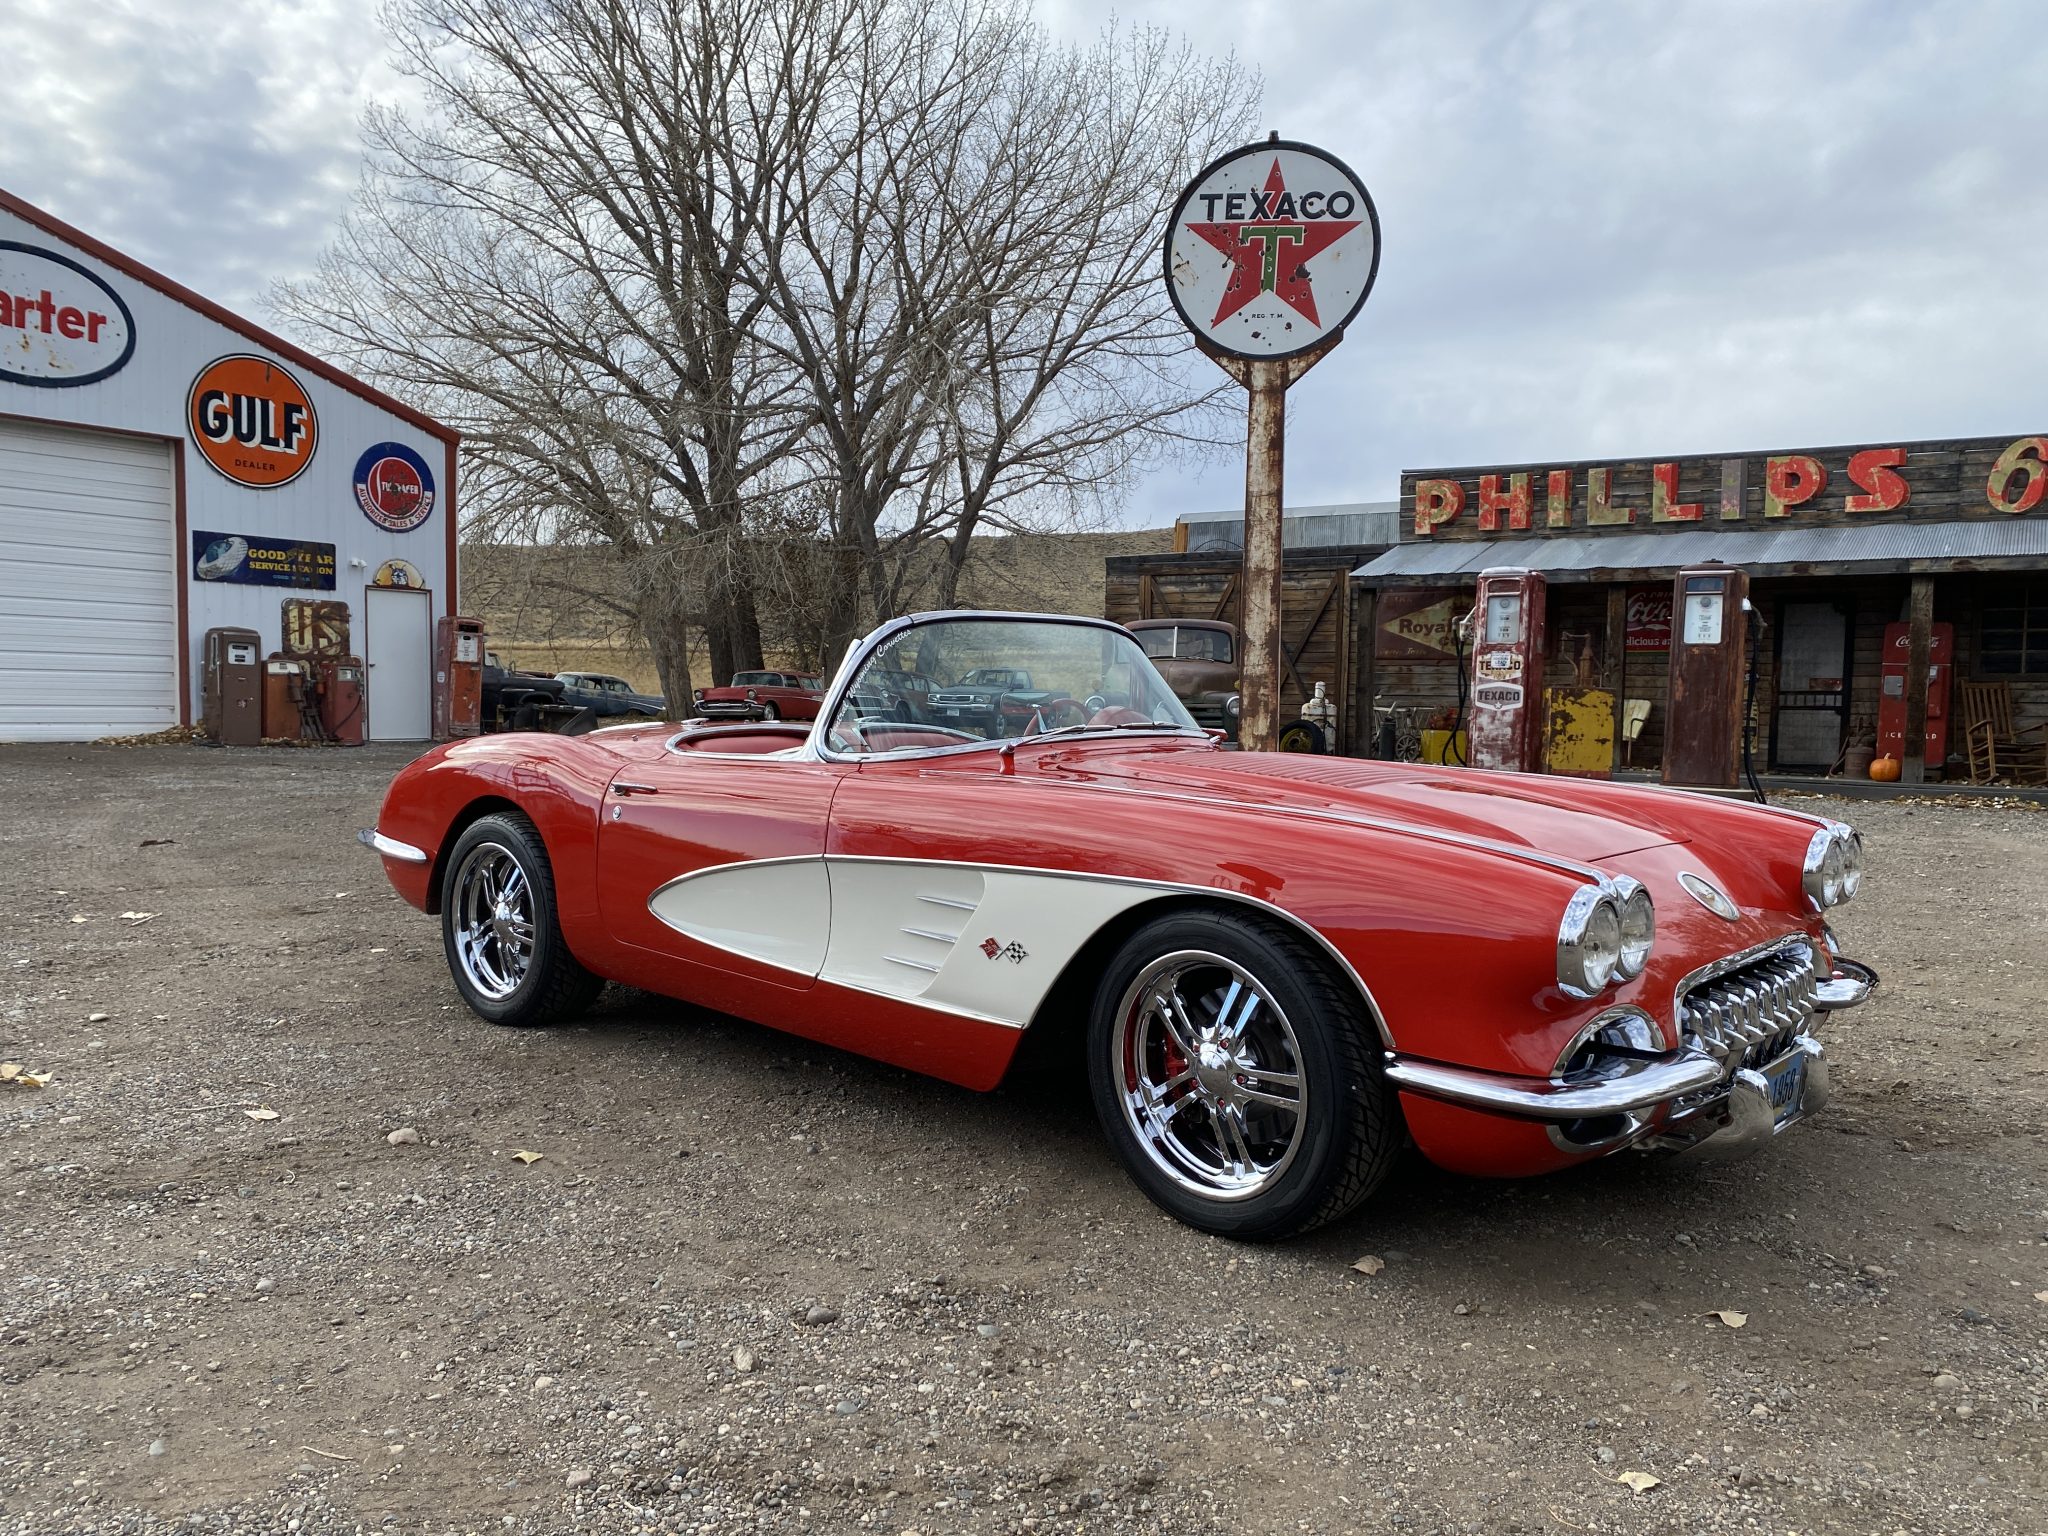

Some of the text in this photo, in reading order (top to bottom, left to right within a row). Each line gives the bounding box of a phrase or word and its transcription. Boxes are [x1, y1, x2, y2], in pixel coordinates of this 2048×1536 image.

[1199, 190, 1356, 222] TEXACO
[199, 389, 309, 456] GULF
[234, 458, 276, 473] DEALER
[1413, 446, 1912, 537] PHILLIPS
[249, 561, 291, 572] SERVICE
[876, 629, 912, 657] Corvettes
[1478, 690, 1520, 701] TEXACO
